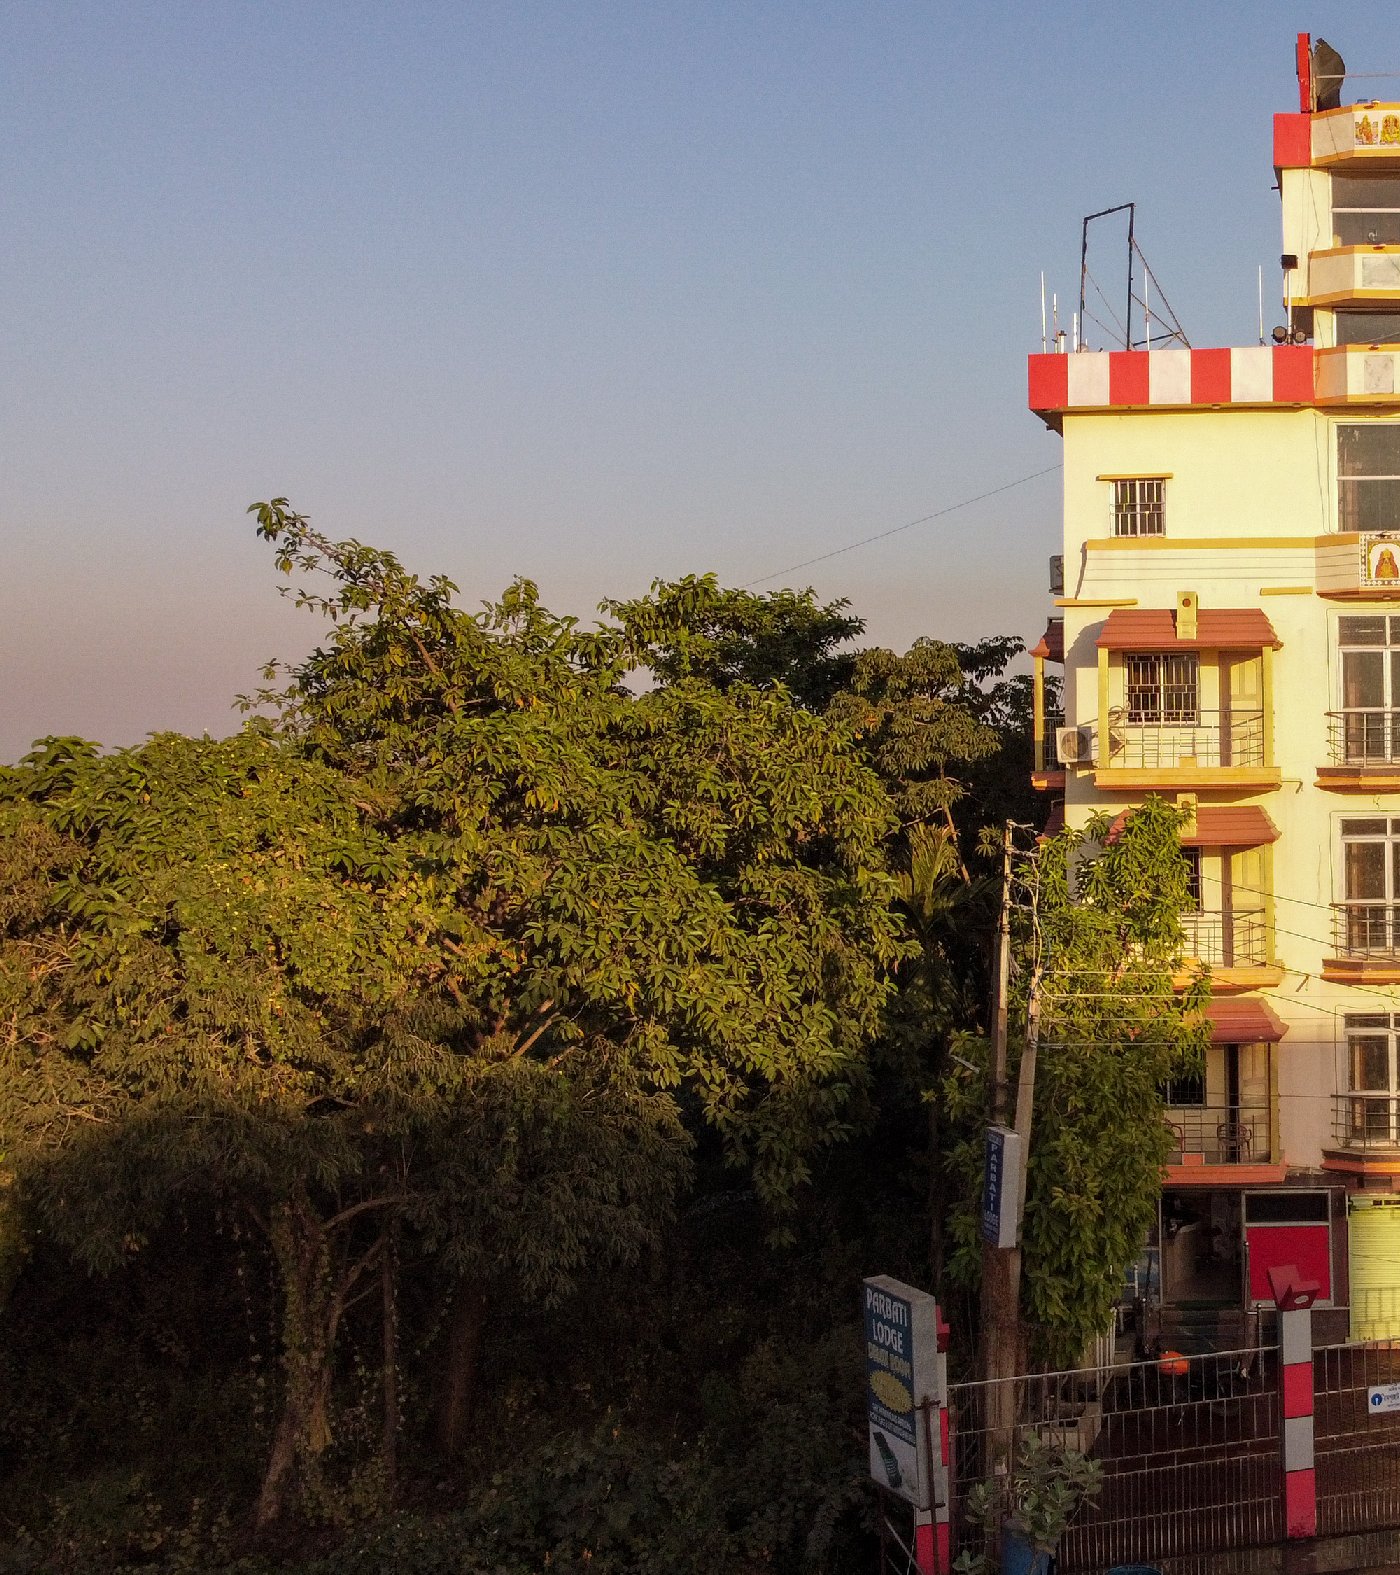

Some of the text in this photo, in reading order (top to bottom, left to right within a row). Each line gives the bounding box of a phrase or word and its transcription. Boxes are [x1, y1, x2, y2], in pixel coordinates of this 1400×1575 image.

[987, 1143, 998, 1211] PARBATI
[866, 1287, 908, 1327] PARBATI
[872, 1319, 904, 1354] LODGE
